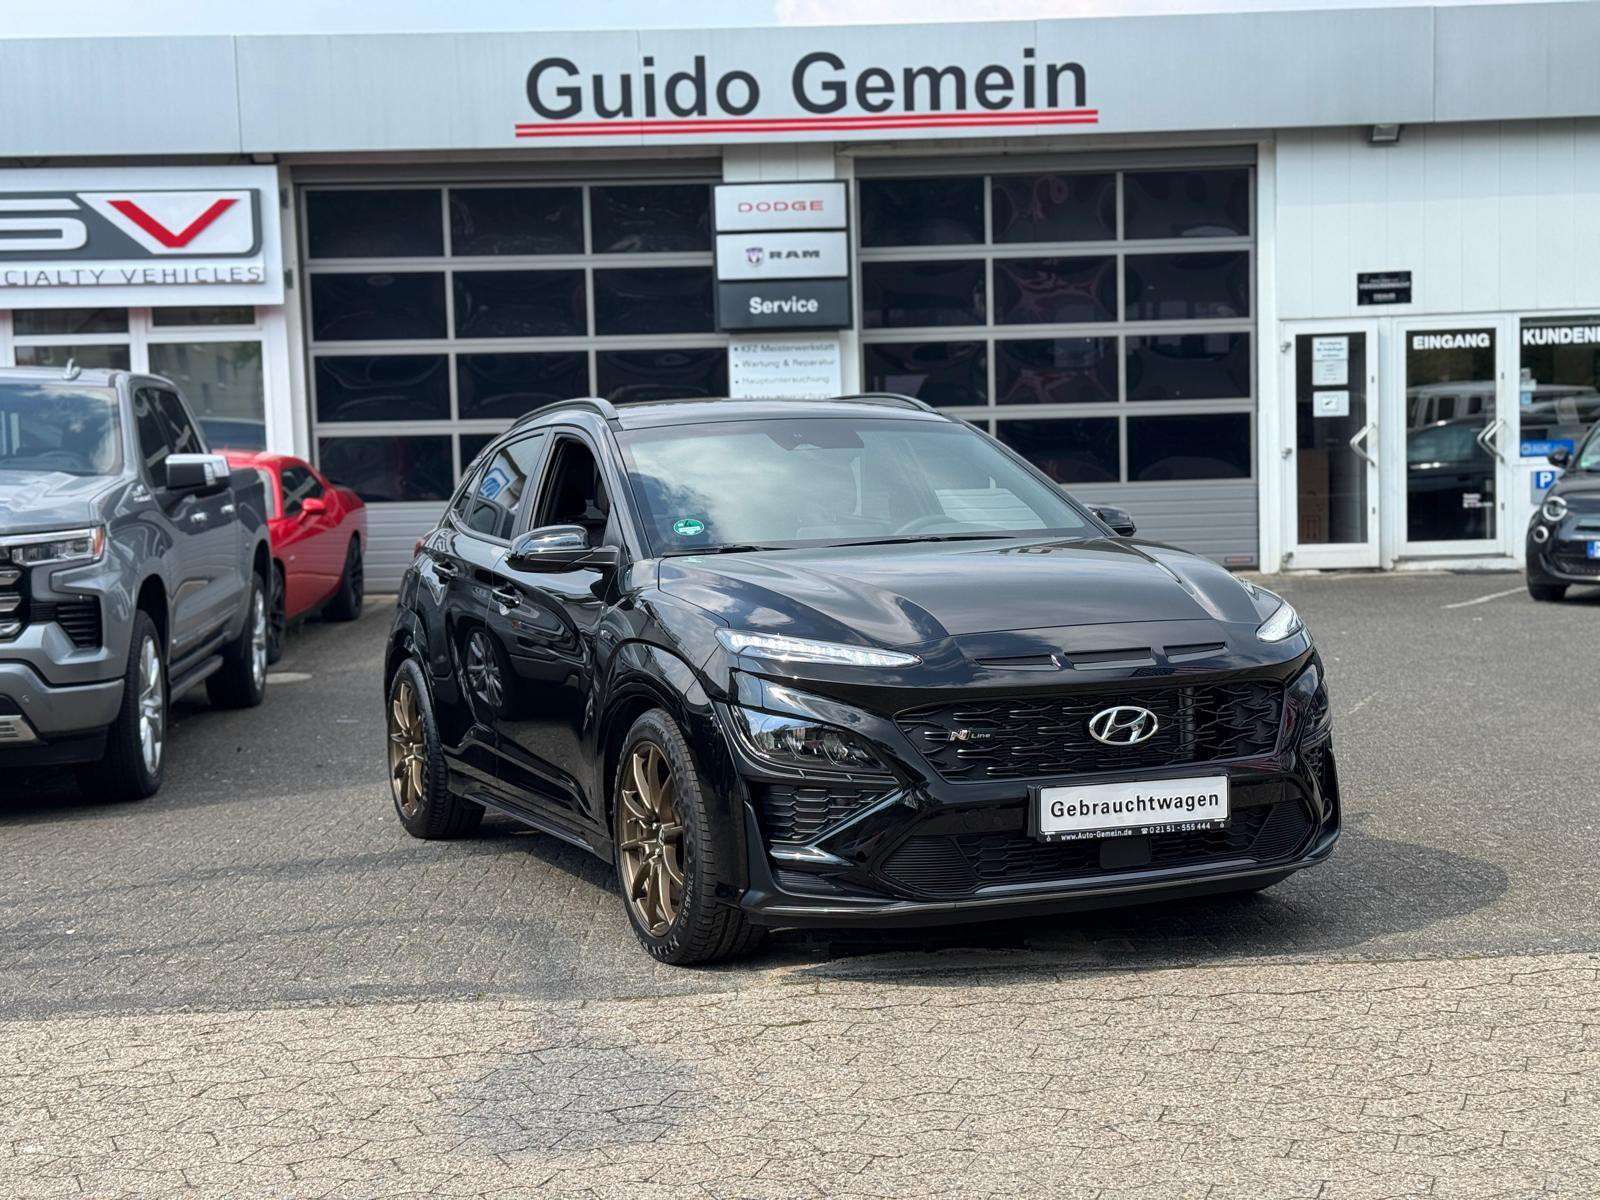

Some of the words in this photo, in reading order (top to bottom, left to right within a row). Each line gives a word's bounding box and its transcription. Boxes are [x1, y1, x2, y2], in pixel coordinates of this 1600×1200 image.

[526, 55, 760, 120] Guido
[791, 47, 1087, 114] Gemein
[737, 200, 824, 213] DODGE
[769, 250, 820, 259] RAM
[4, 268, 104, 287] CIALTY
[121, 267, 261, 285] VEHICLES
[749, 296, 819, 315] Service
[1412, 332, 1491, 350] EINGANG
[1522, 326, 1600, 346] KUNDEN
[1540, 472, 1553, 488] P
[1050, 793, 1219, 818] Gebrauchtwagen
[1061, 829, 1133, 842] www.Auto-Gemein.de
